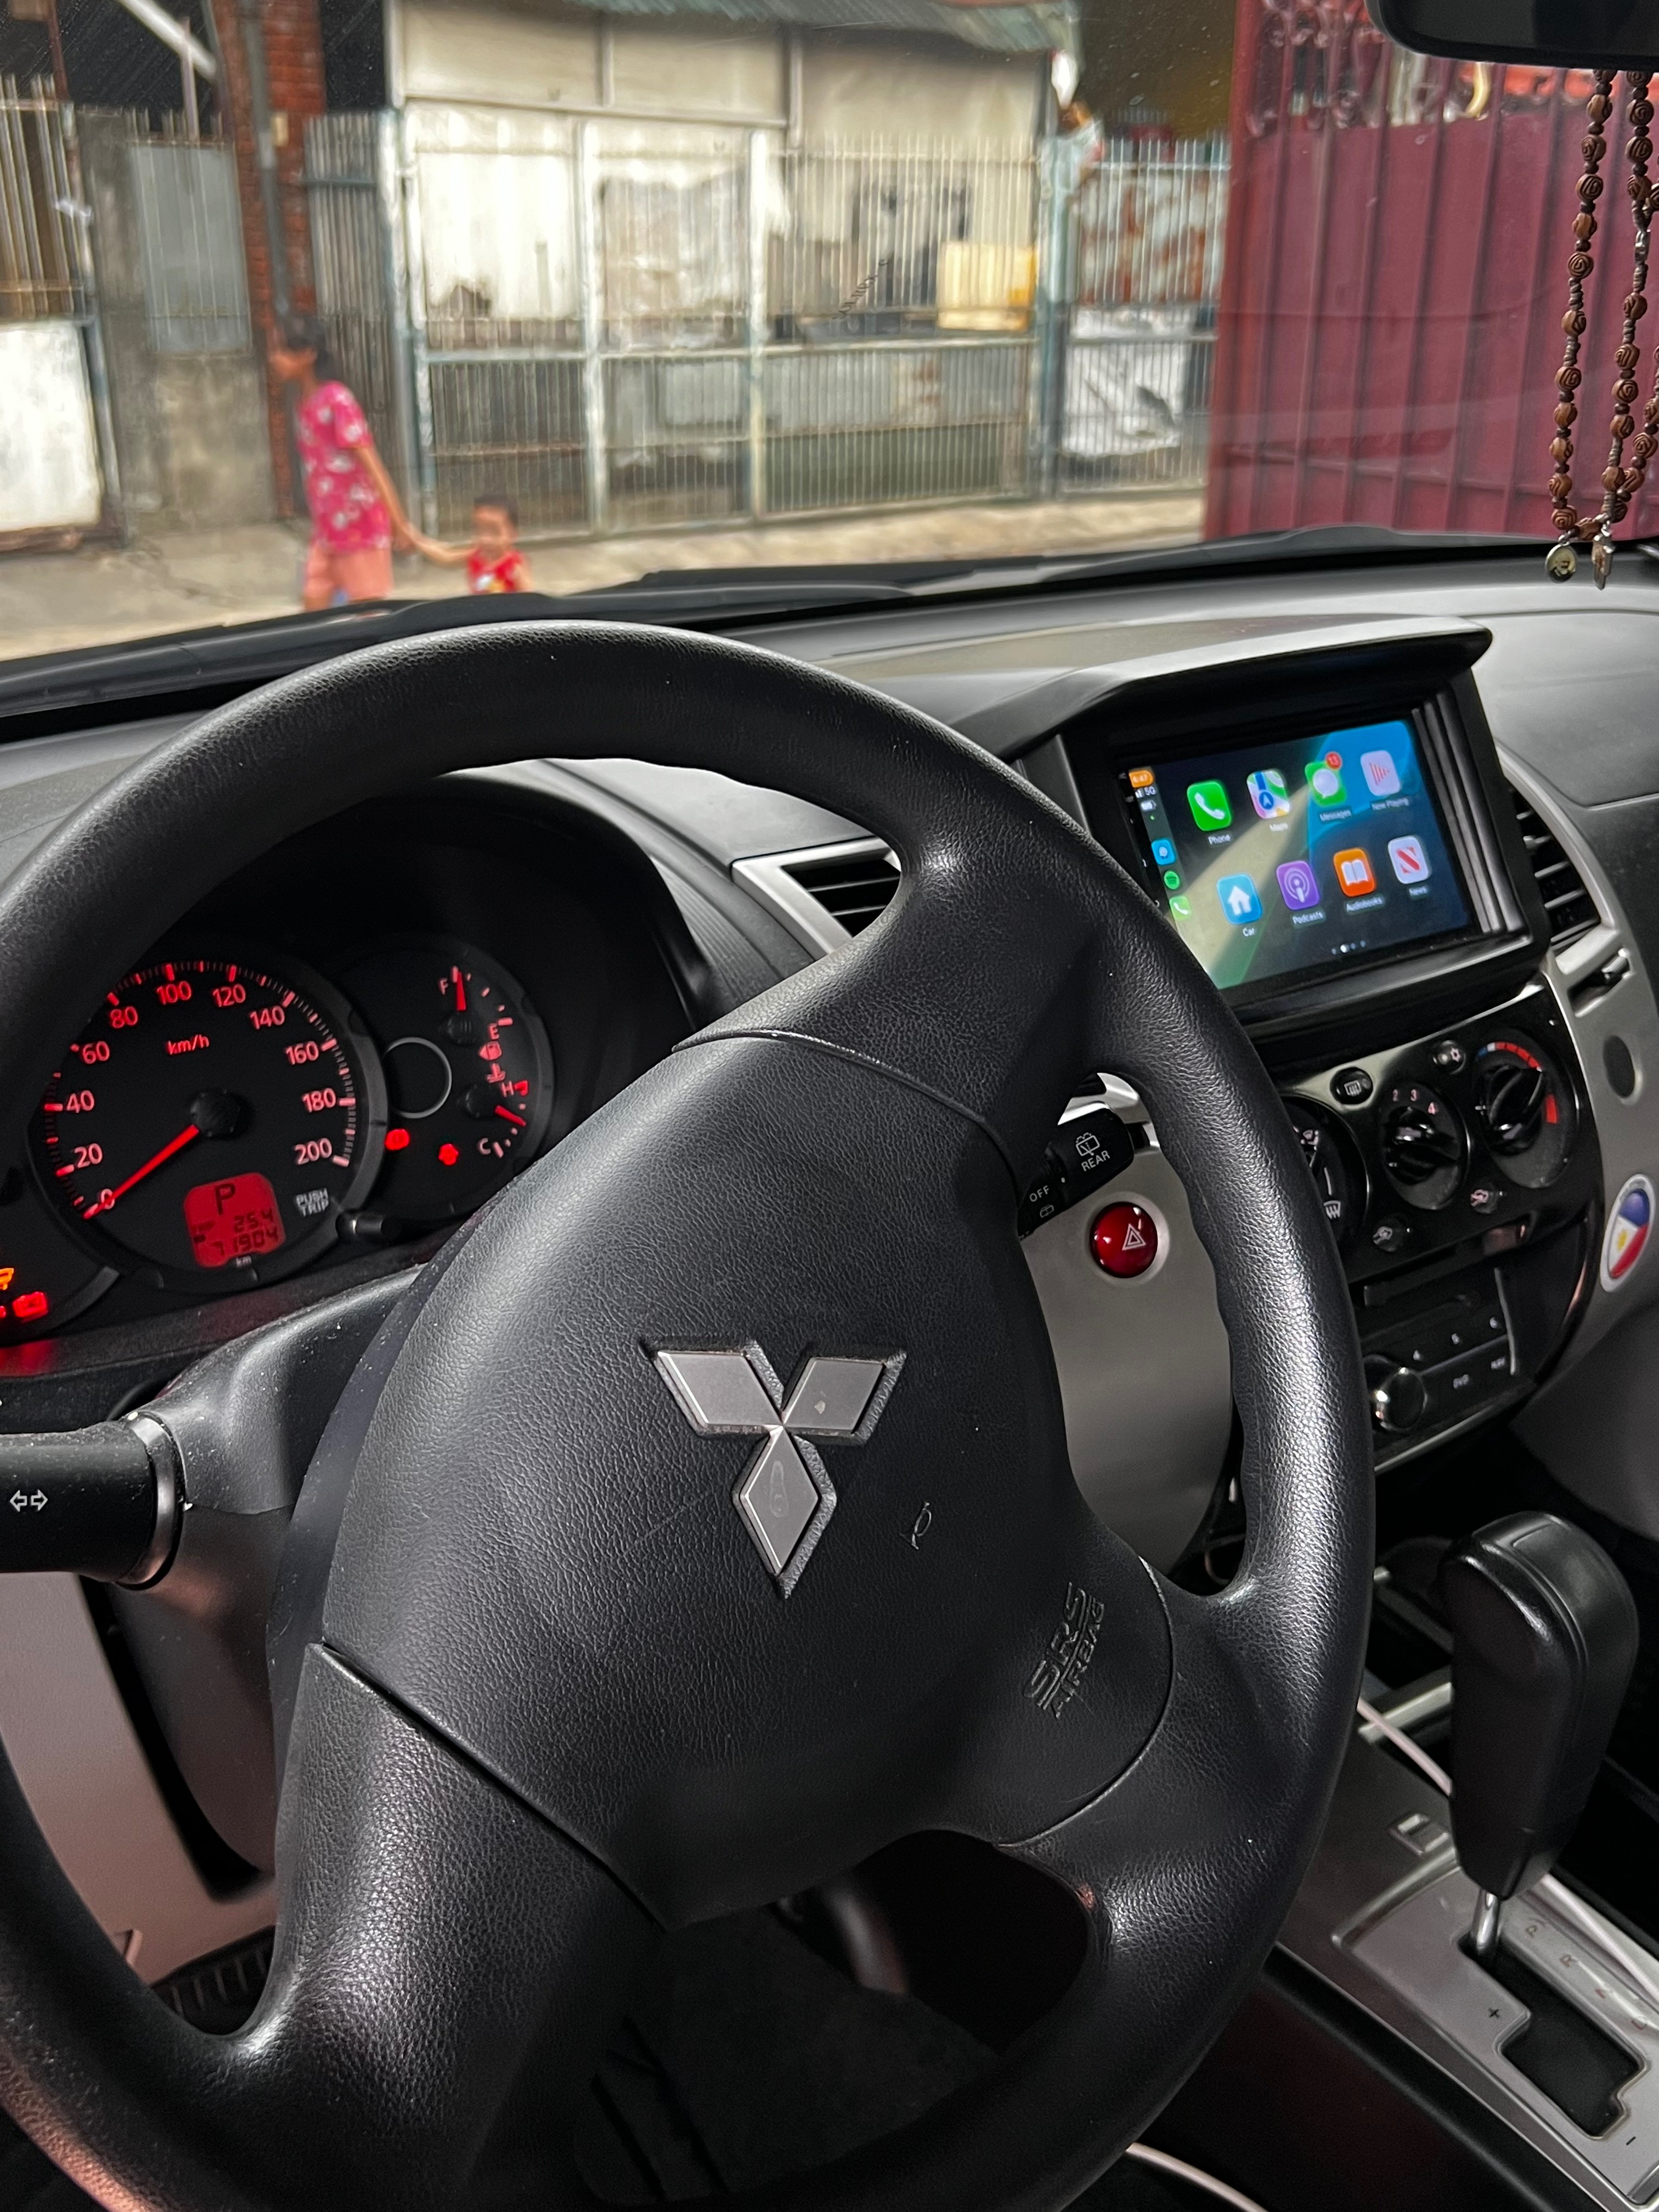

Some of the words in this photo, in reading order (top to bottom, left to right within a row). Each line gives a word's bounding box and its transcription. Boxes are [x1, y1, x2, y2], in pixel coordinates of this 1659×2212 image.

[1144, 786, 1156, 795] 5G
[1319, 809, 1352, 822] Messages
[1269, 822, 1289, 832] Maps
[1209, 833, 1231, 845] Phone
[1408, 885, 1427, 896] News
[1346, 896, 1384, 912] Audiobooks
[1293, 911, 1324, 925] Podcasts
[1242, 927, 1256, 937] Car
[156, 981, 192, 1005] 100
[212, 984, 247, 1007] 120
[439, 978, 448, 995] F
[109, 1006, 139, 1029] 80
[250, 1005, 285, 1030] 140
[488, 1023, 499, 1040] E
[82, 1040, 110, 1064] 60
[167, 1034, 210, 1055] km/h
[285, 1041, 319, 1065] 160
[501, 1081, 515, 1097] H
[66, 1090, 95, 1113] 40
[302, 1088, 336, 1113] 180
[1392, 1089, 1398, 1102] 2
[1410, 1089, 1417, 1102] 3
[1428, 1102, 1436, 1115] 4
[74, 1143, 103, 1167] 20
[294, 1138, 332, 1165] 200
[478, 1137, 491, 1155] C
[1081, 1150, 1110, 1172] REAR
[99, 1188, 115, 1210] 0
[215, 1183, 236, 1215] P
[296, 1188, 329, 1205] PUSH
[1029, 1185, 1050, 1202] OFF
[298, 1200, 329, 1216] TRIP
[236, 1255, 252, 1268] km
[1024, 1582, 1086, 1707] SRS
[1051, 1596, 1104, 1719] AIRBAG
